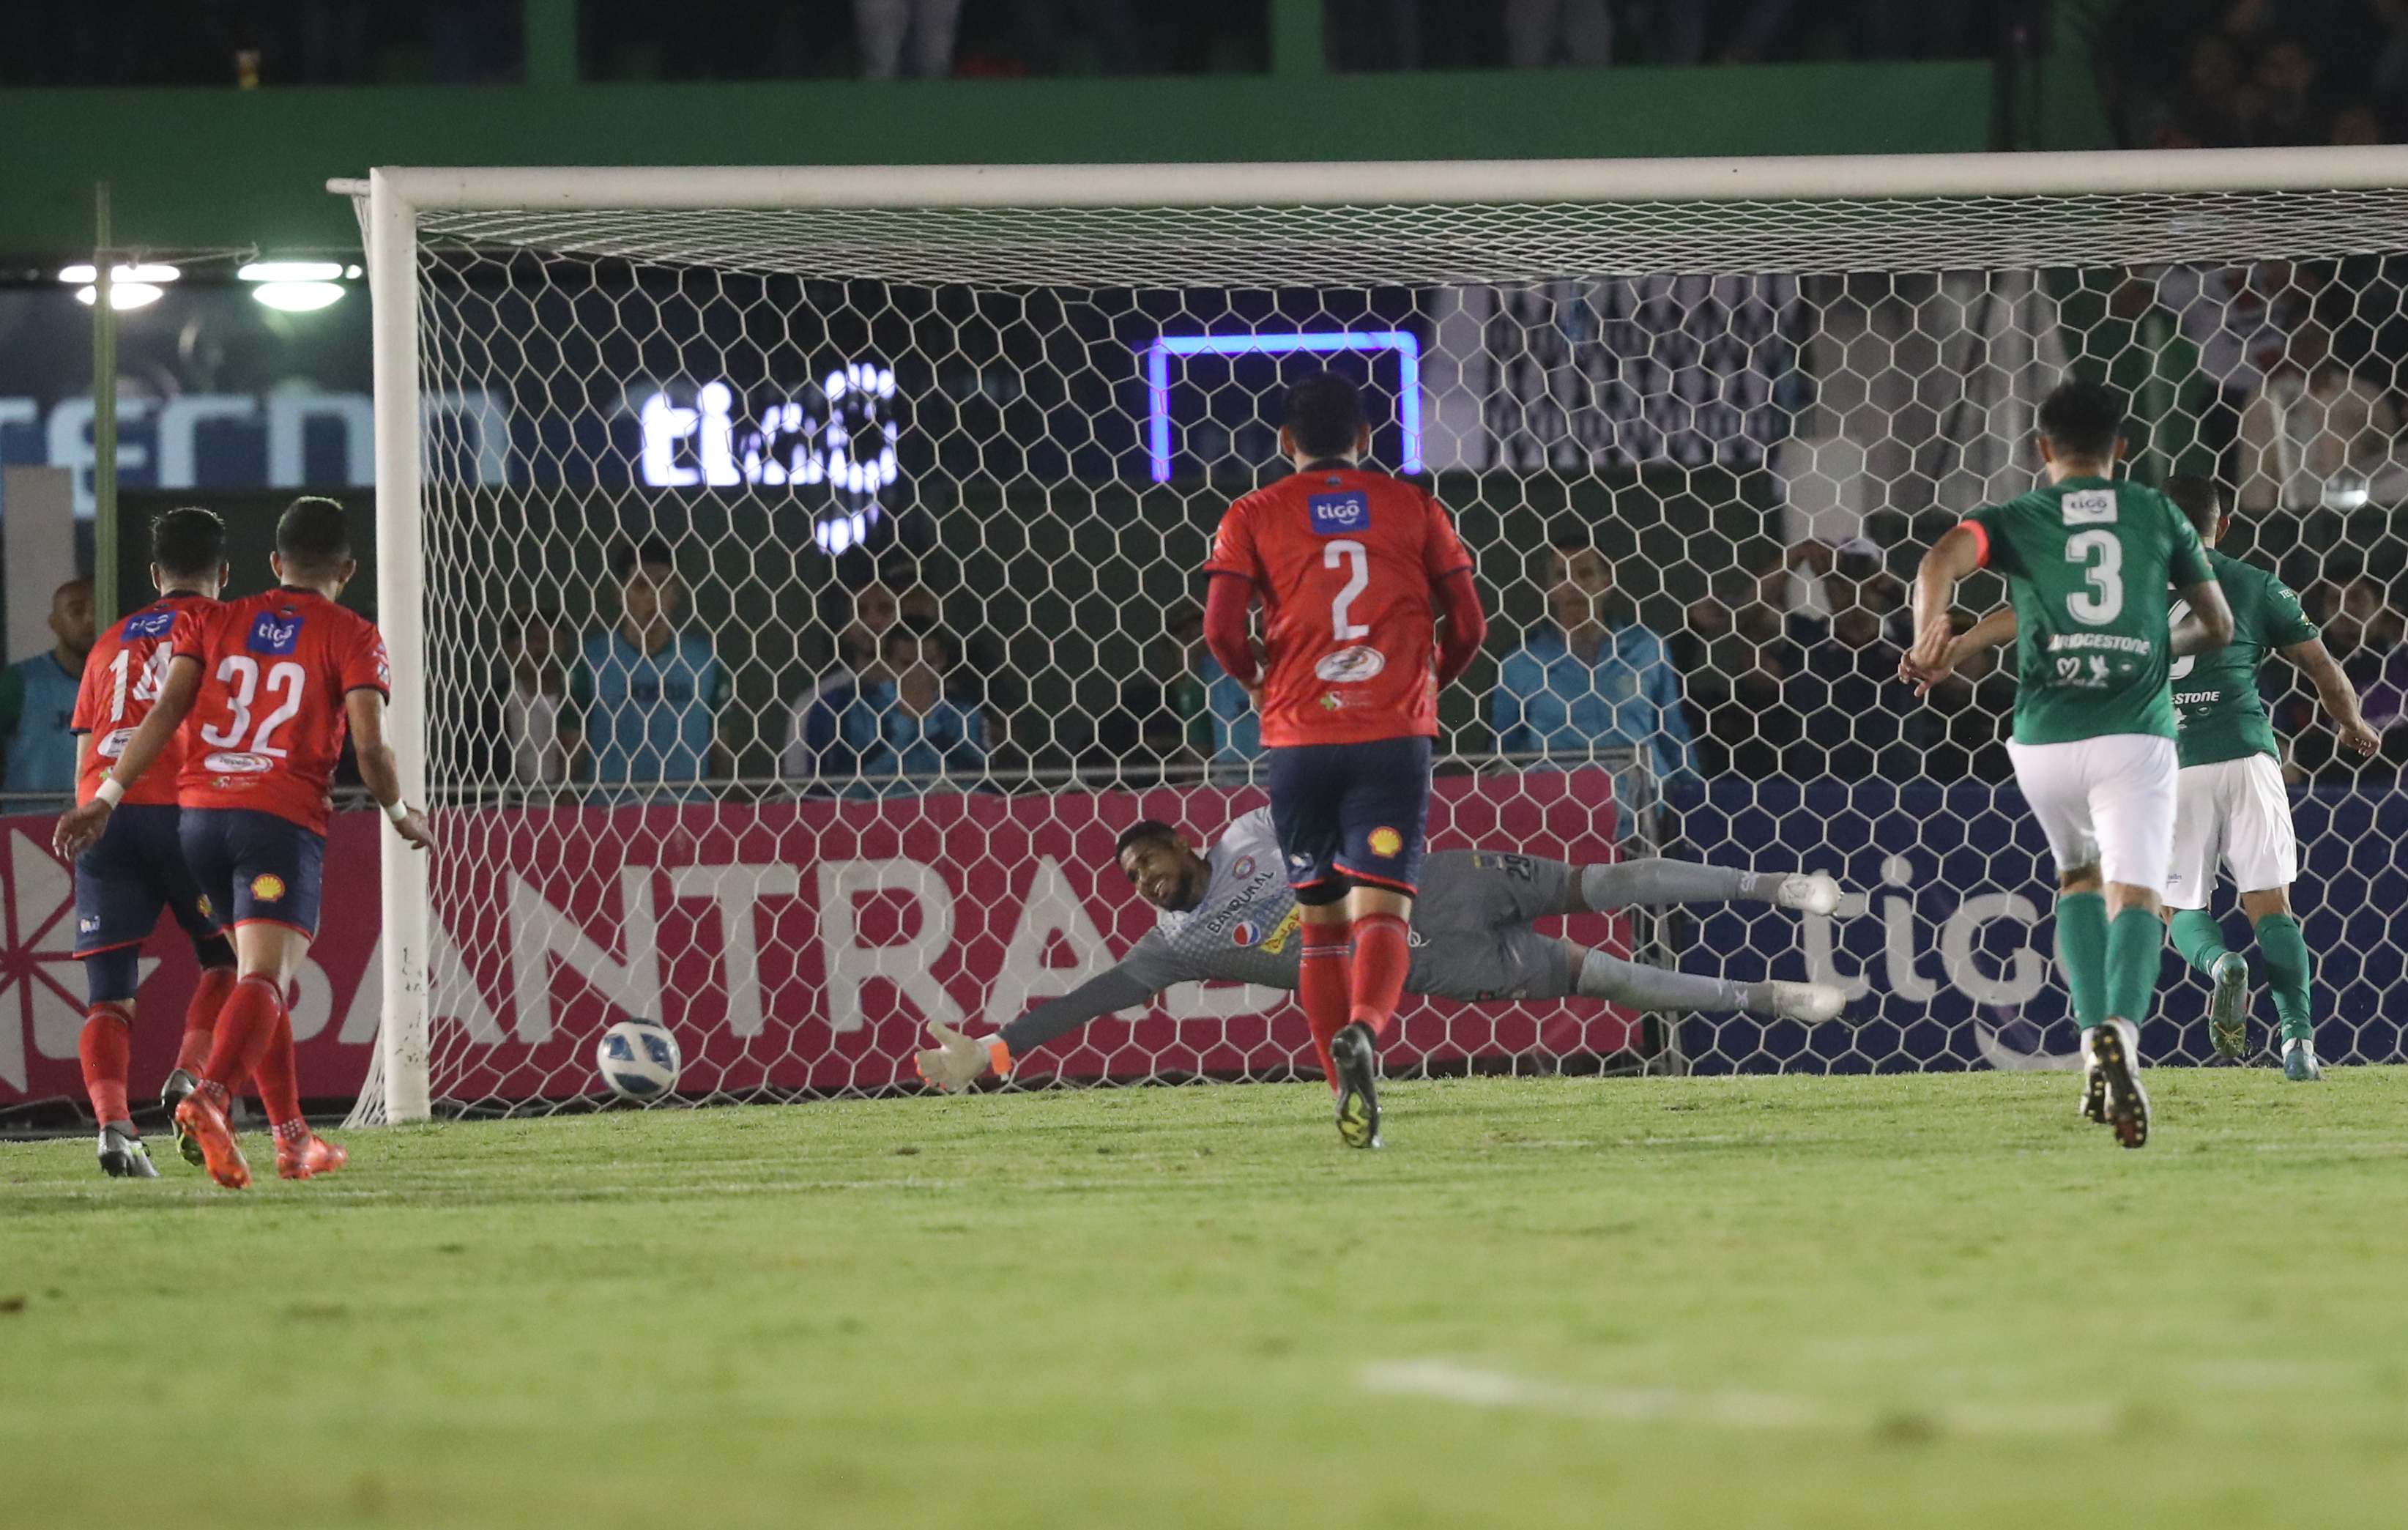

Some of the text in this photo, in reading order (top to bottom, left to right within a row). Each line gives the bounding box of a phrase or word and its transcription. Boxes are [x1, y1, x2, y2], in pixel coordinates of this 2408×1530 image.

[1323, 539, 1370, 642] 2
[2065, 529, 2123, 626] 3
[109, 642, 173, 723] 14
[201, 655, 305, 758] 32
